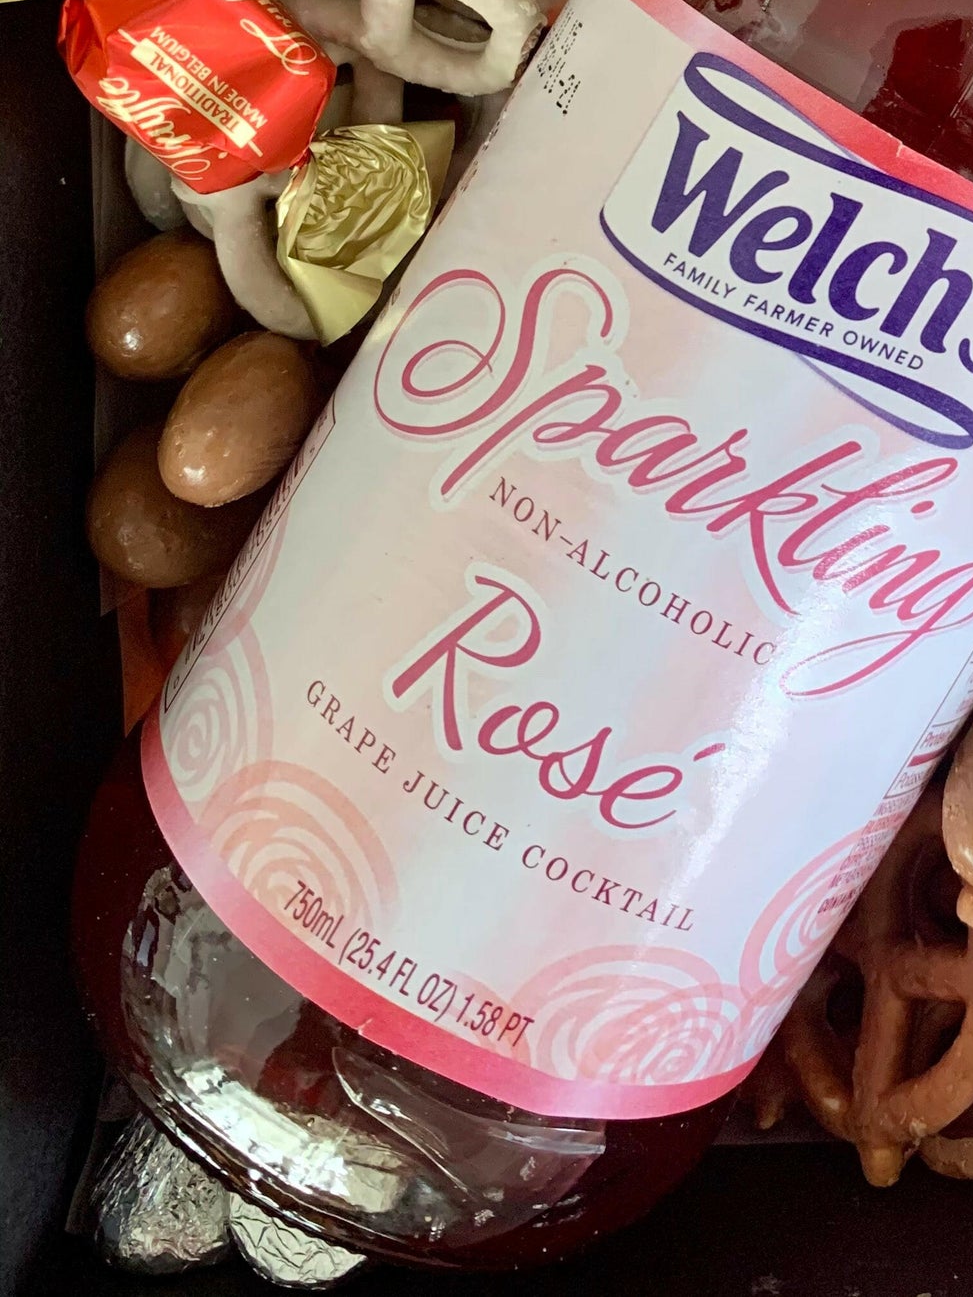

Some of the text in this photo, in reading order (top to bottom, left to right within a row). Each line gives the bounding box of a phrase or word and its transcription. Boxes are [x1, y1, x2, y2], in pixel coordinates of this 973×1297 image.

[149, 50, 241, 135] TRADITIONAL
[150, 26, 267, 130] MADE IN BELGIUM
[663, 252, 925, 372] FAMILY FARMER OWNED
[488, 476, 778, 667] NON-ALCOHOLIC
[391, 575, 726, 830] Rosé
[306, 679, 695, 933] GRAPE JUICE COCKTAIL
[284, 880, 535, 1049] 750mL (25.4 FL OZ) 1.58 PT
